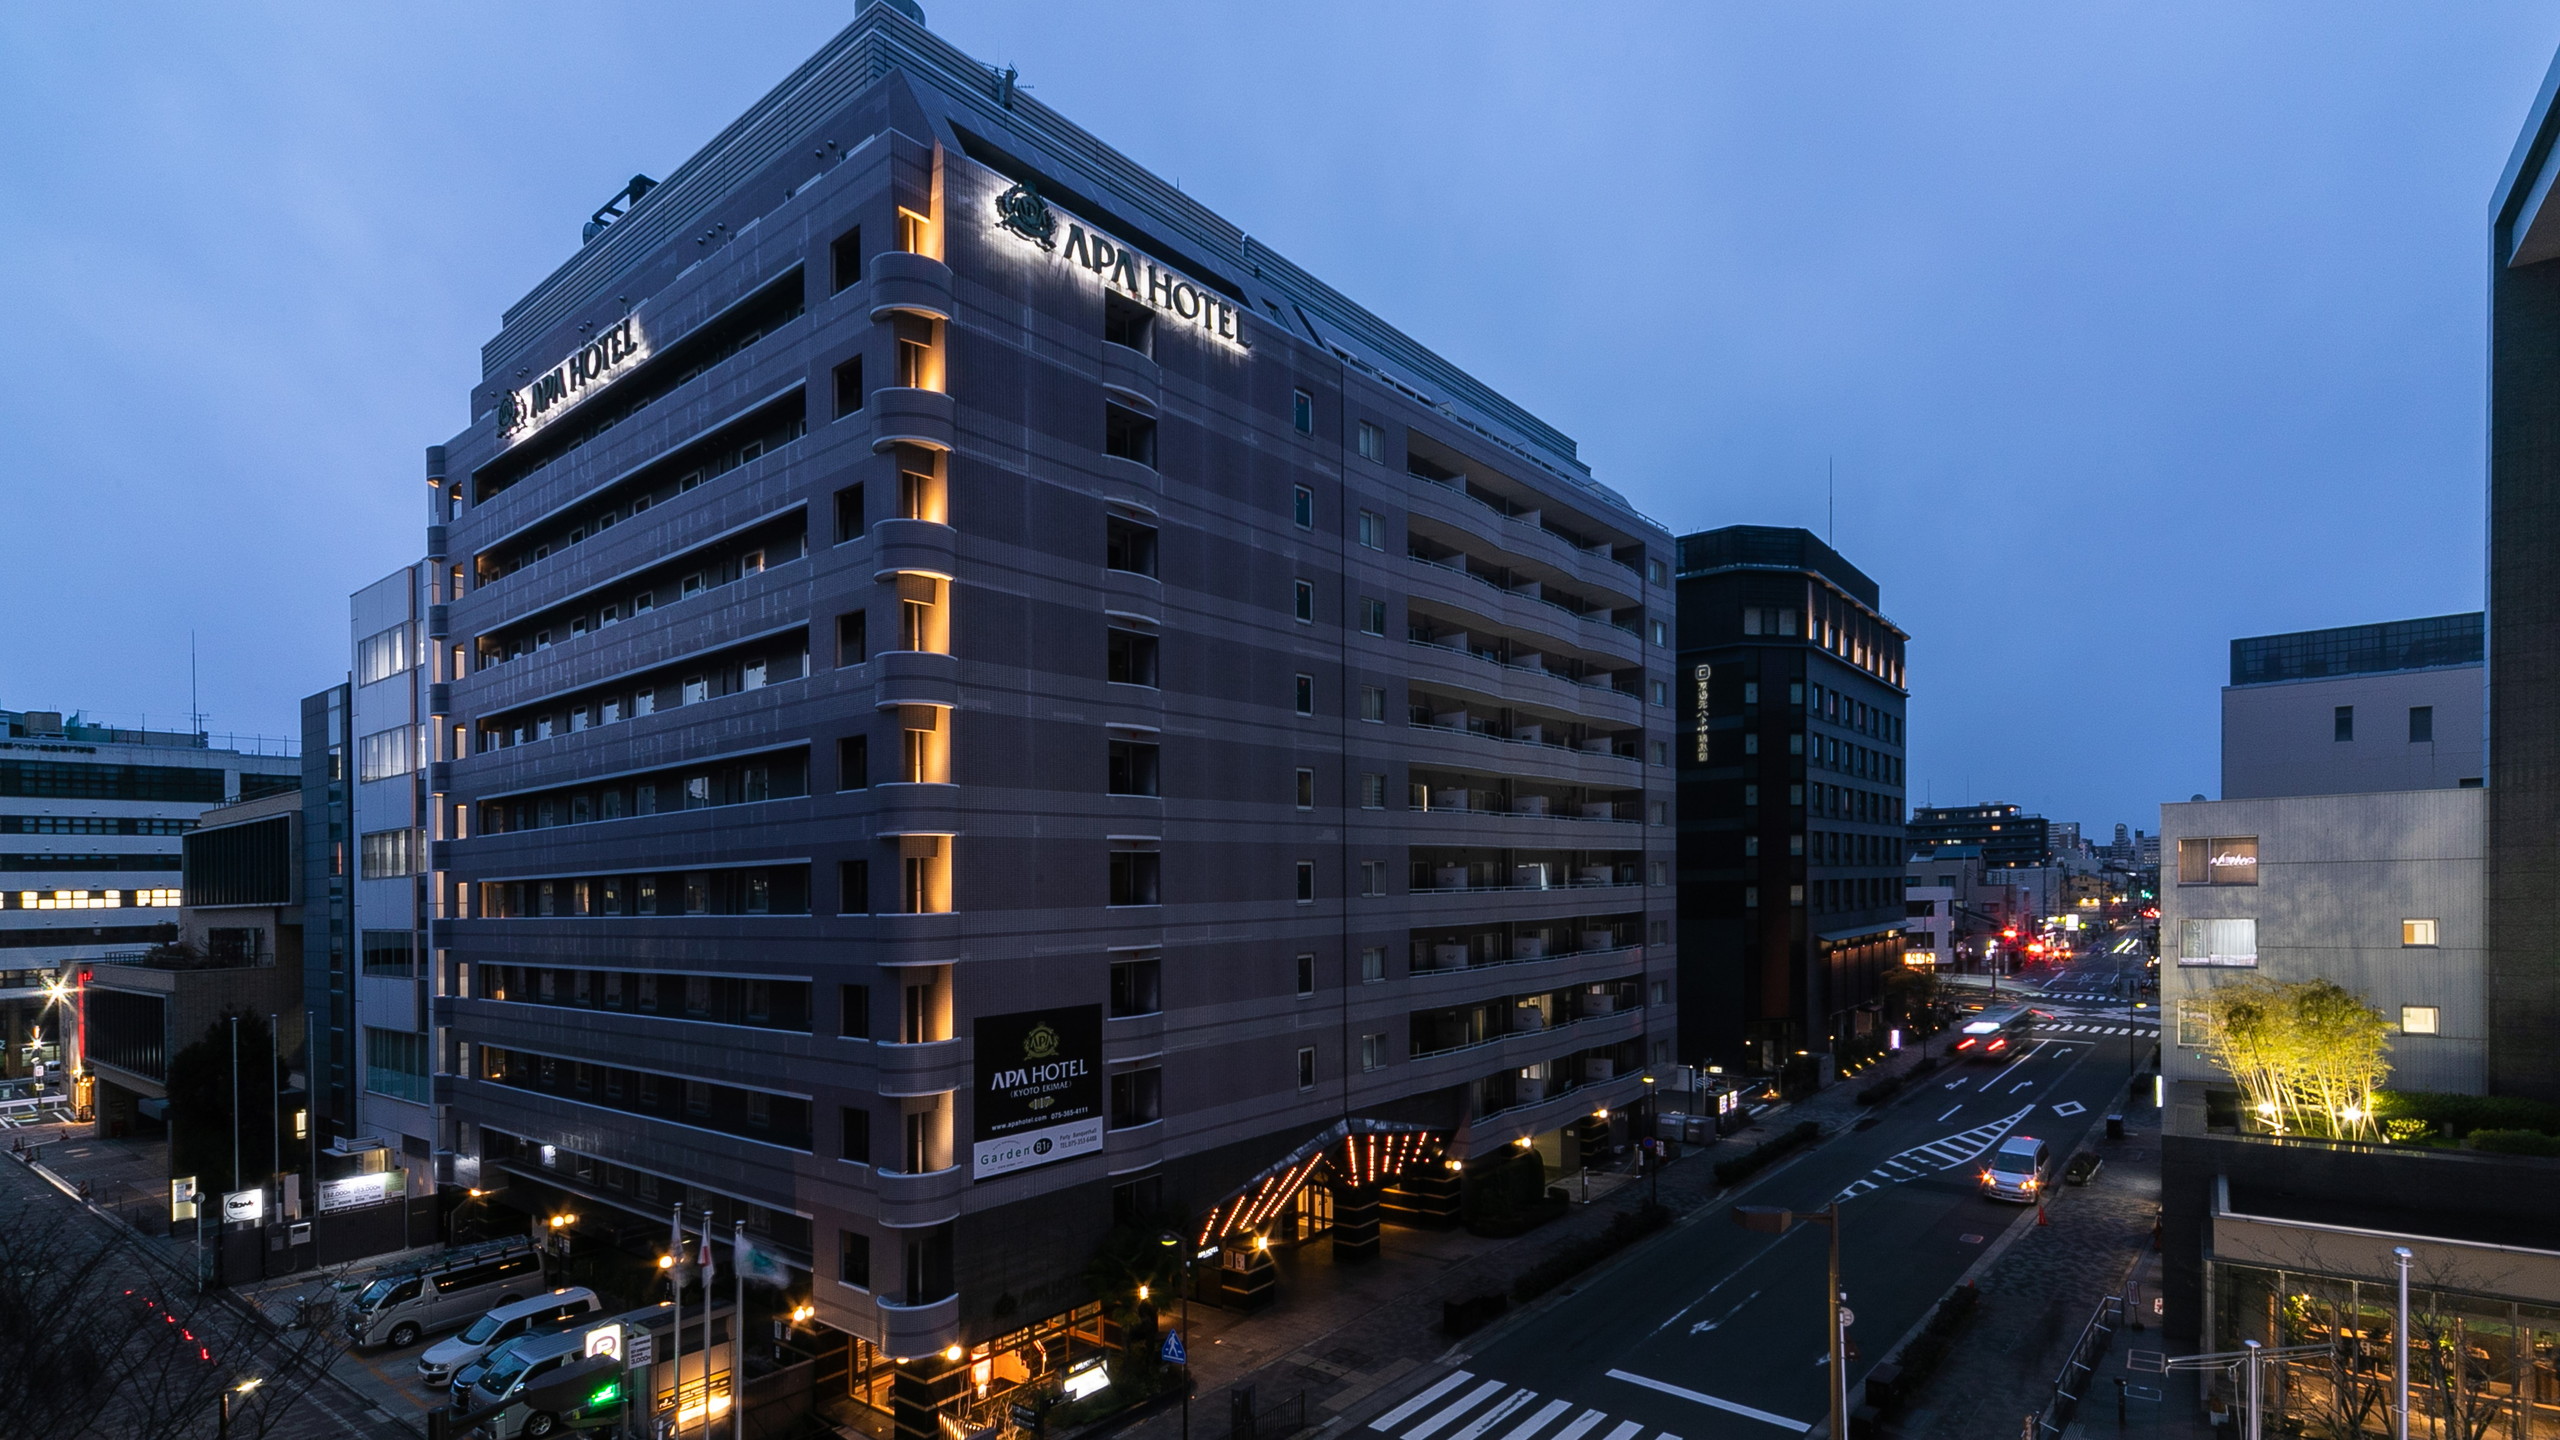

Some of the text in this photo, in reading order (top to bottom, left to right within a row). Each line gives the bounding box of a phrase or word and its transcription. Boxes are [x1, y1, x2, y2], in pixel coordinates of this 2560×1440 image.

[1063, 223, 1252, 349] APA HOTEL
[531, 319, 638, 418] APA HOTEL
[991, 1059, 1088, 1091] APA HOTEL
[1010, 1080, 1072, 1099] (KYOTO EKIMAE)
[991, 1114, 1047, 1131] www.apahotel.com
[980, 1146, 1030, 1165] Garden
